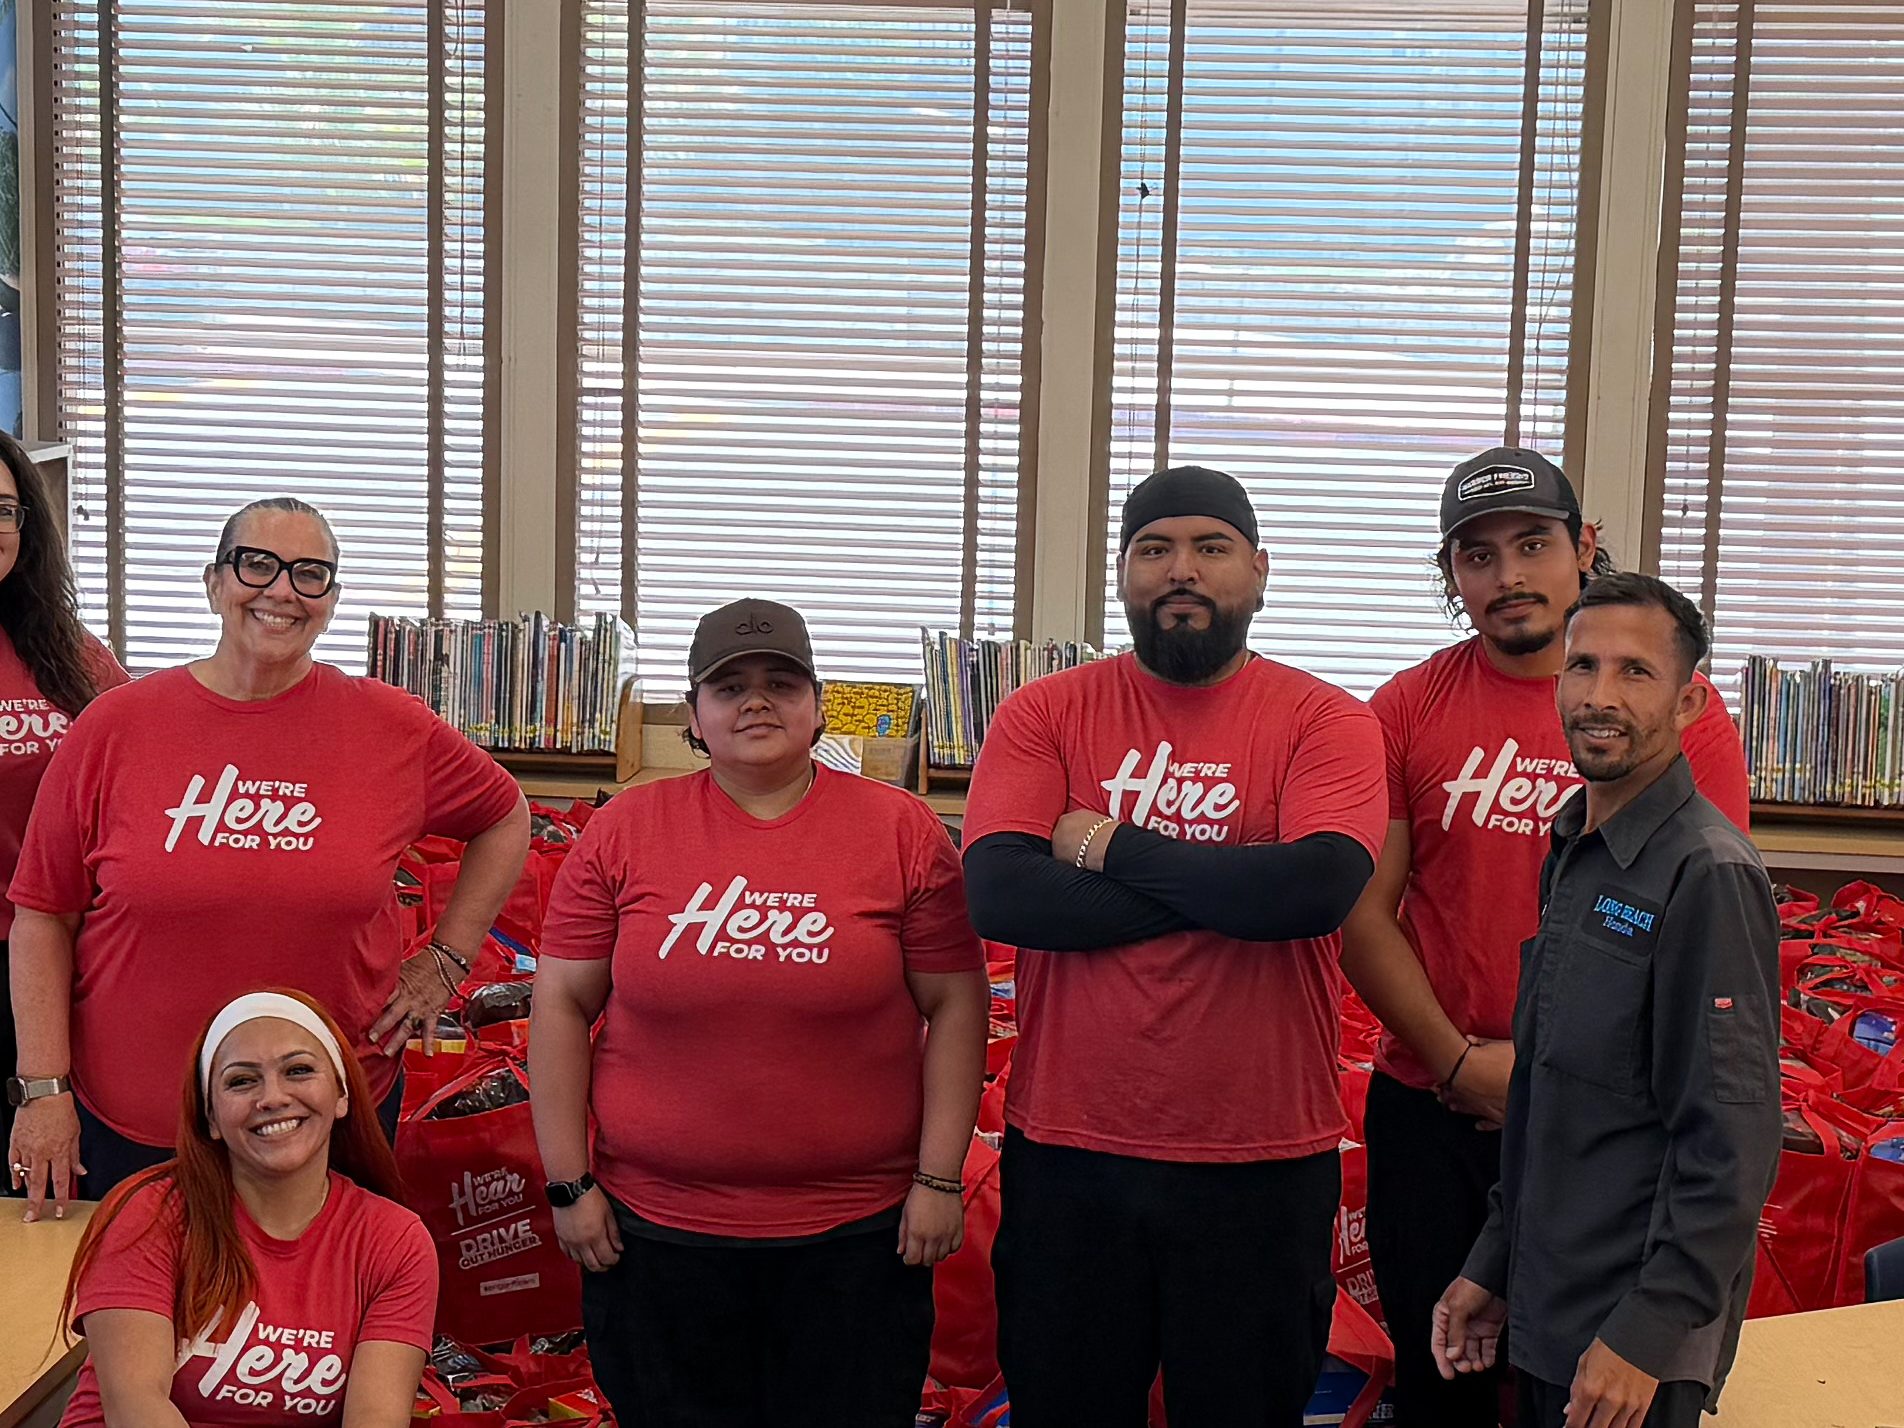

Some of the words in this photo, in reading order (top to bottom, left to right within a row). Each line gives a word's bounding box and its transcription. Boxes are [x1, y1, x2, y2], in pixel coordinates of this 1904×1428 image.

[1168, 758, 1232, 778] WE'RE
[237, 780, 308, 798] WE'RE
[1100, 740, 1240, 827] Here
[1442, 737, 1584, 832] Her
[164, 763, 323, 853] Here
[1184, 824, 1228, 842] YOU
[1487, 814, 1534, 836] FOR
[214, 832, 261, 850] FOR
[267, 835, 315, 851] YOU
[745, 891, 817, 907] WE'RE
[658, 875, 835, 960] Here
[1621, 905, 1655, 932] BEACH
[713, 942, 766, 960] FOR
[776, 947, 829, 964] YOU
[448, 1170, 526, 1226] Hear
[478, 1202, 499, 1215] FOR
[501, 1193, 523, 1207] YOU
[459, 1219, 533, 1257] DRIVE
[176, 1300, 347, 1398] Here
[257, 1322, 335, 1349] WE'RE
[215, 1384, 274, 1407] FOR
[283, 1395, 336, 1416] YOU
